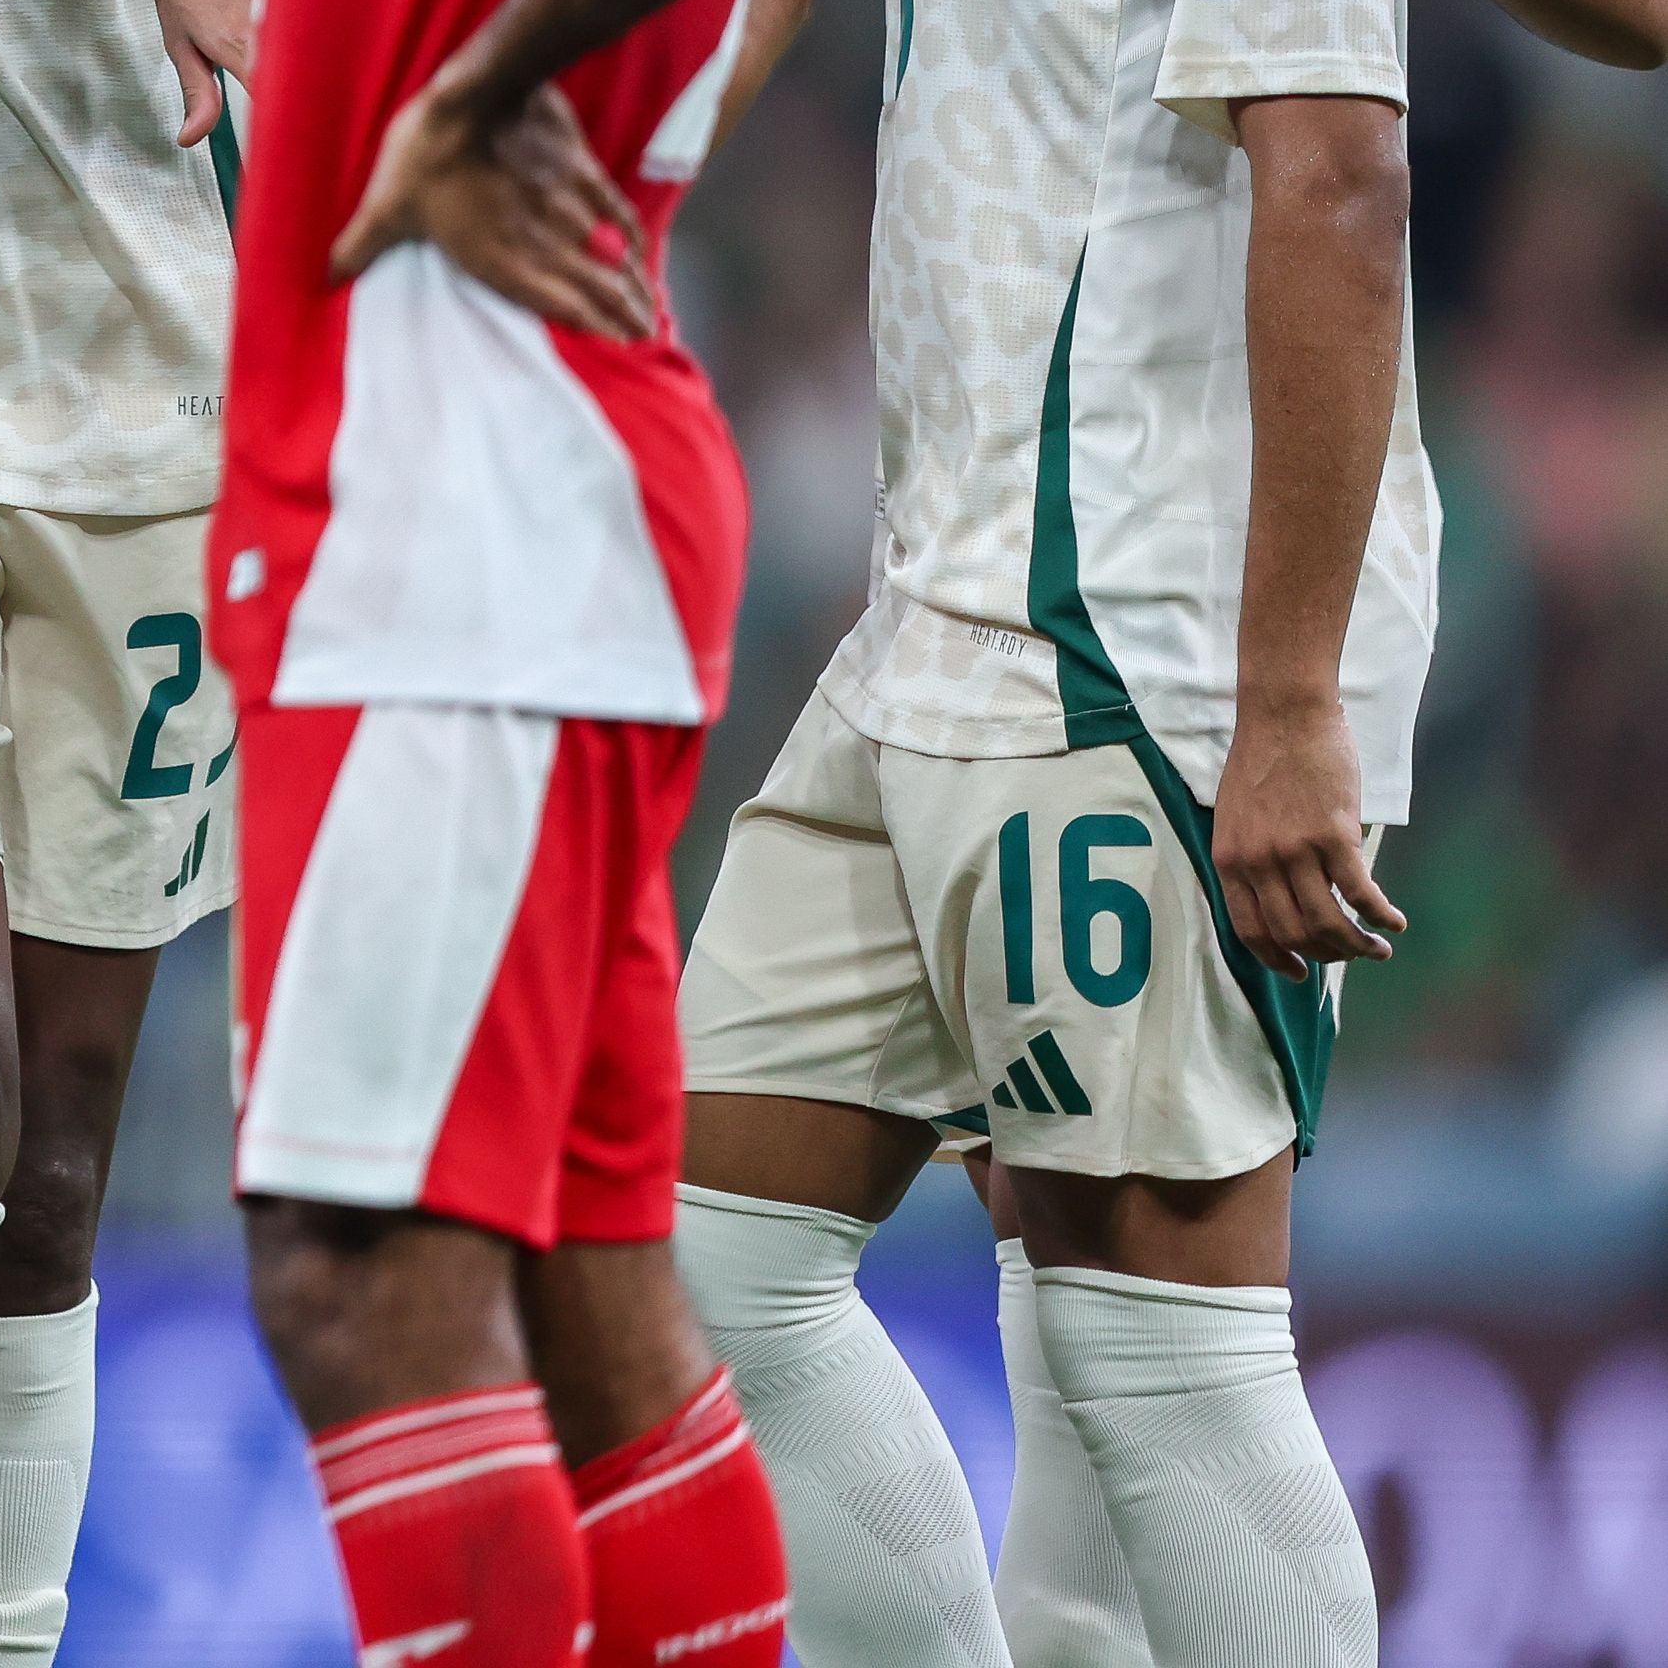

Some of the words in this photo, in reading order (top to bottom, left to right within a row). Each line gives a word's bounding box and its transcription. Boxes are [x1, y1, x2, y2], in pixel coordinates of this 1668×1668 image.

[177, 395, 225, 416] HEAT
[969, 621, 1028, 659] HEAT.RDY
[120, 611, 240, 800] 2
[998, 810, 1153, 1009] 16
